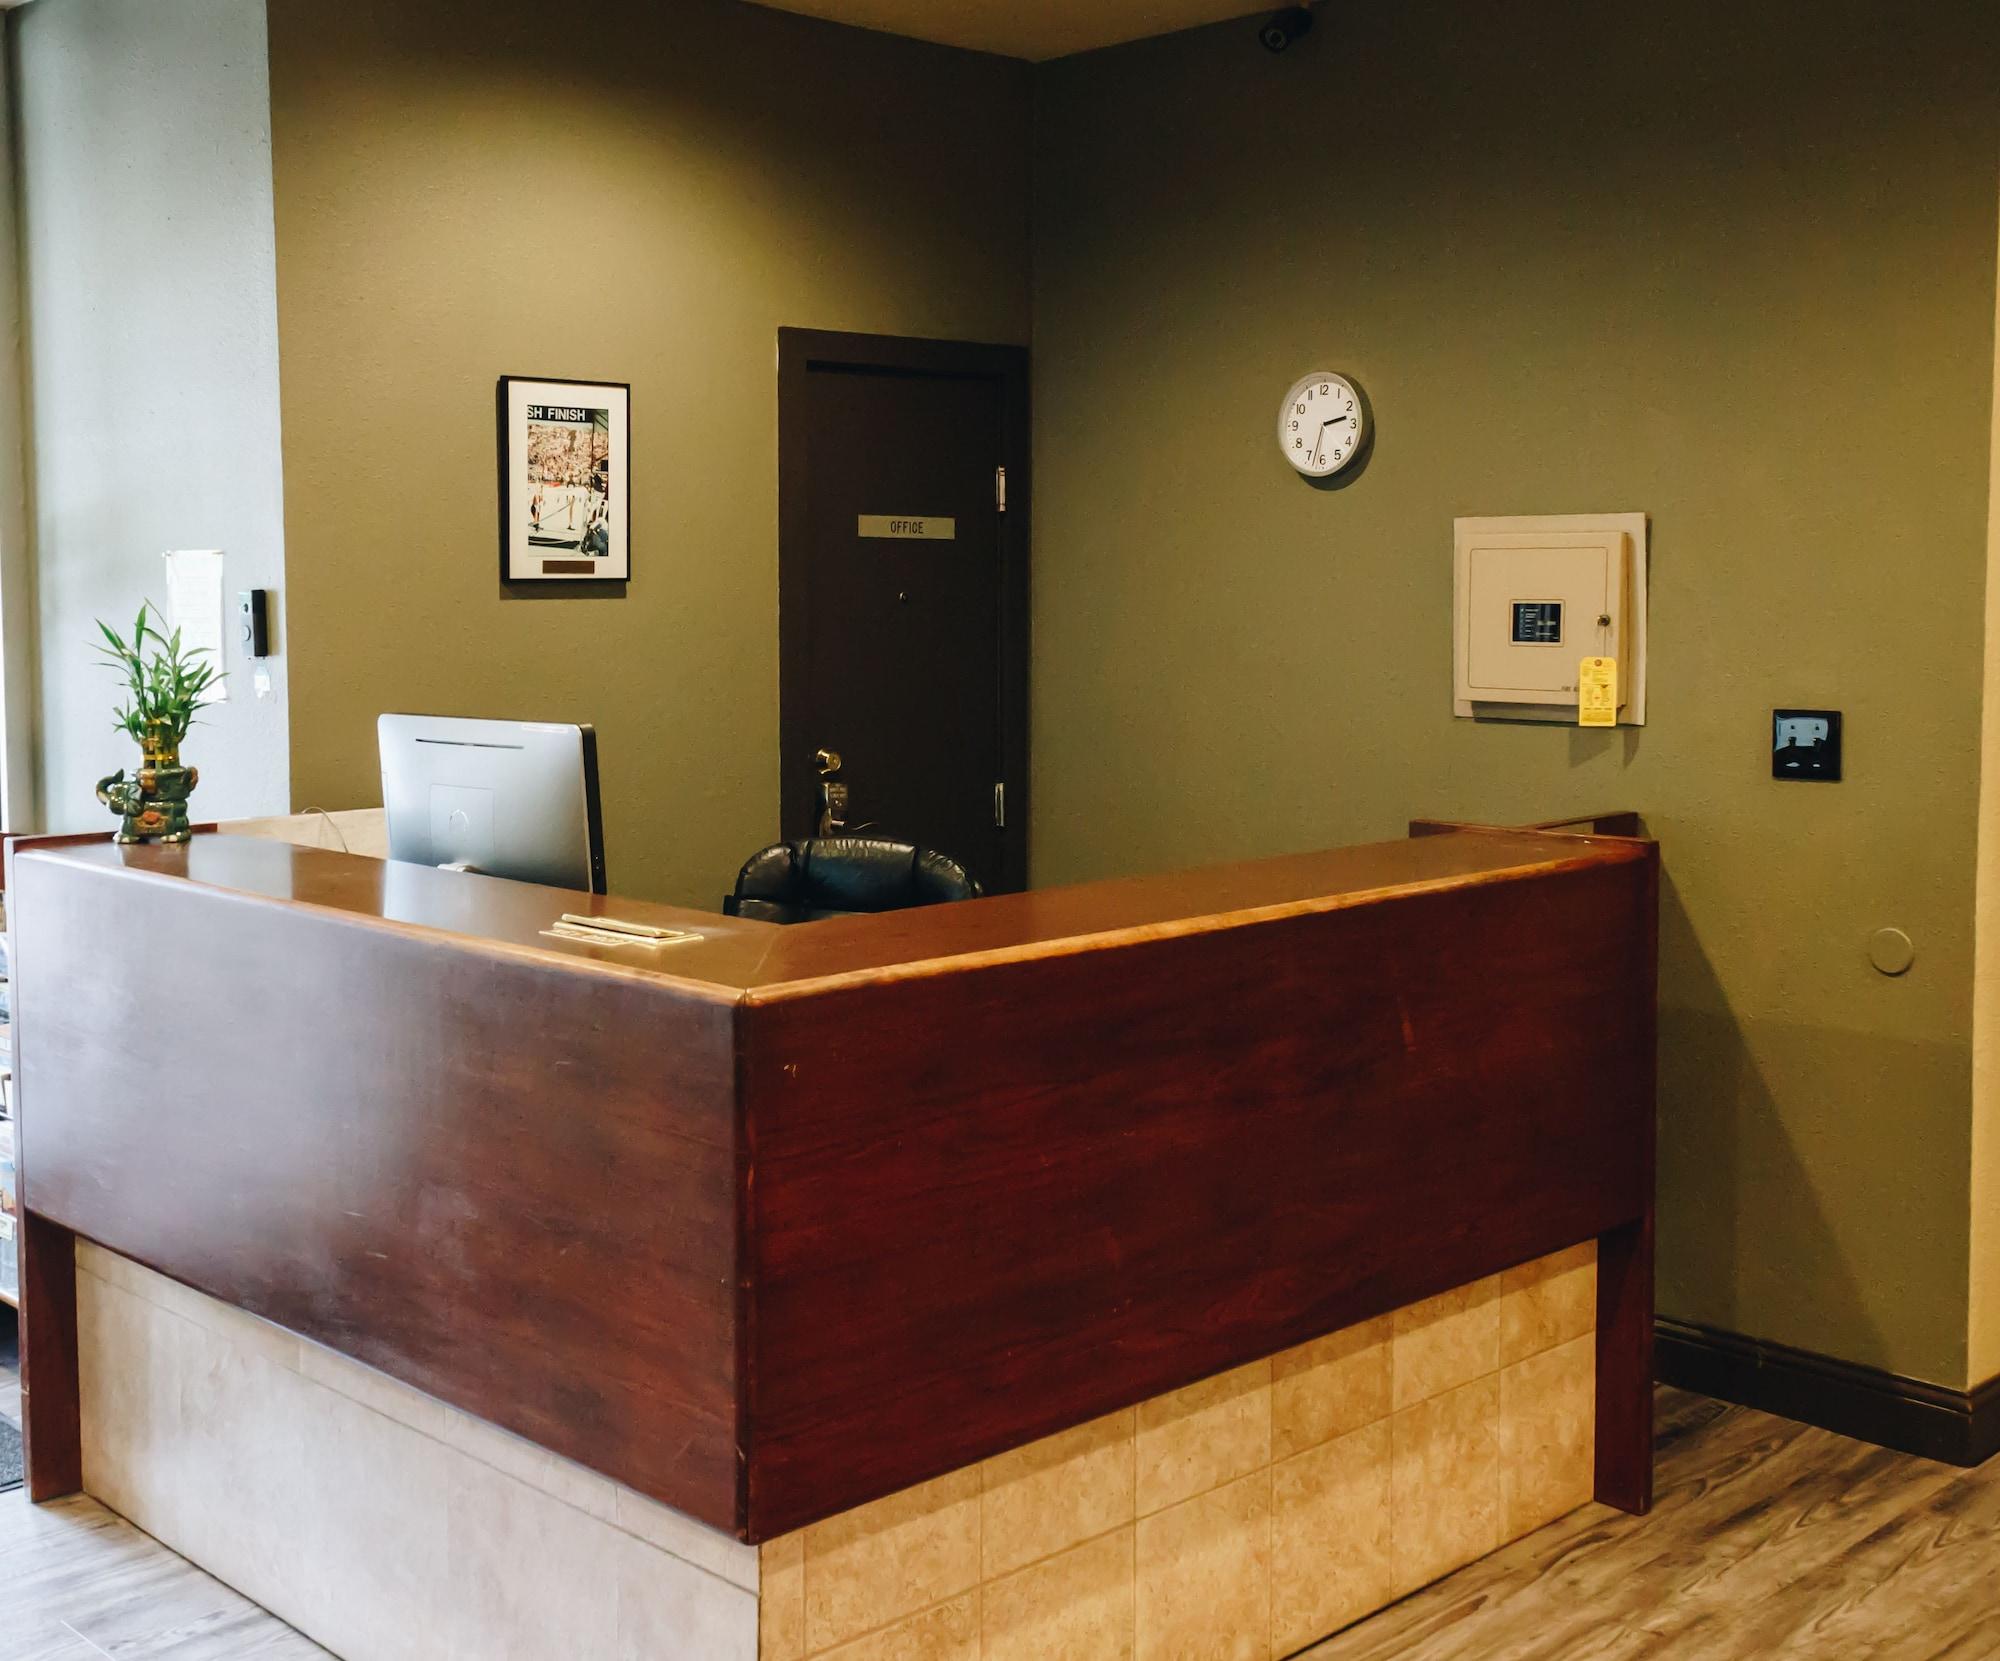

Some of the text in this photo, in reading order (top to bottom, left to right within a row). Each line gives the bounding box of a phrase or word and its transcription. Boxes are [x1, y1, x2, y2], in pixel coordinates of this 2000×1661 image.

[1307, 390, 1313, 401] 11
[1319, 385, 1329, 396] 12
[1296, 404, 1306, 415] 10
[1346, 400, 1353, 412] 2
[547, 407, 586, 421] FINISH
[1292, 421, 1298, 431] 9
[1350, 418, 1356, 429] 3
[1295, 438, 1303, 449] 8
[1345, 436, 1352, 447] 4
[1306, 450, 1312, 461] 7
[1319, 454, 1326, 465] 6
[1334, 449, 1341, 460] 5
[890, 520, 924, 535] OFFICE
